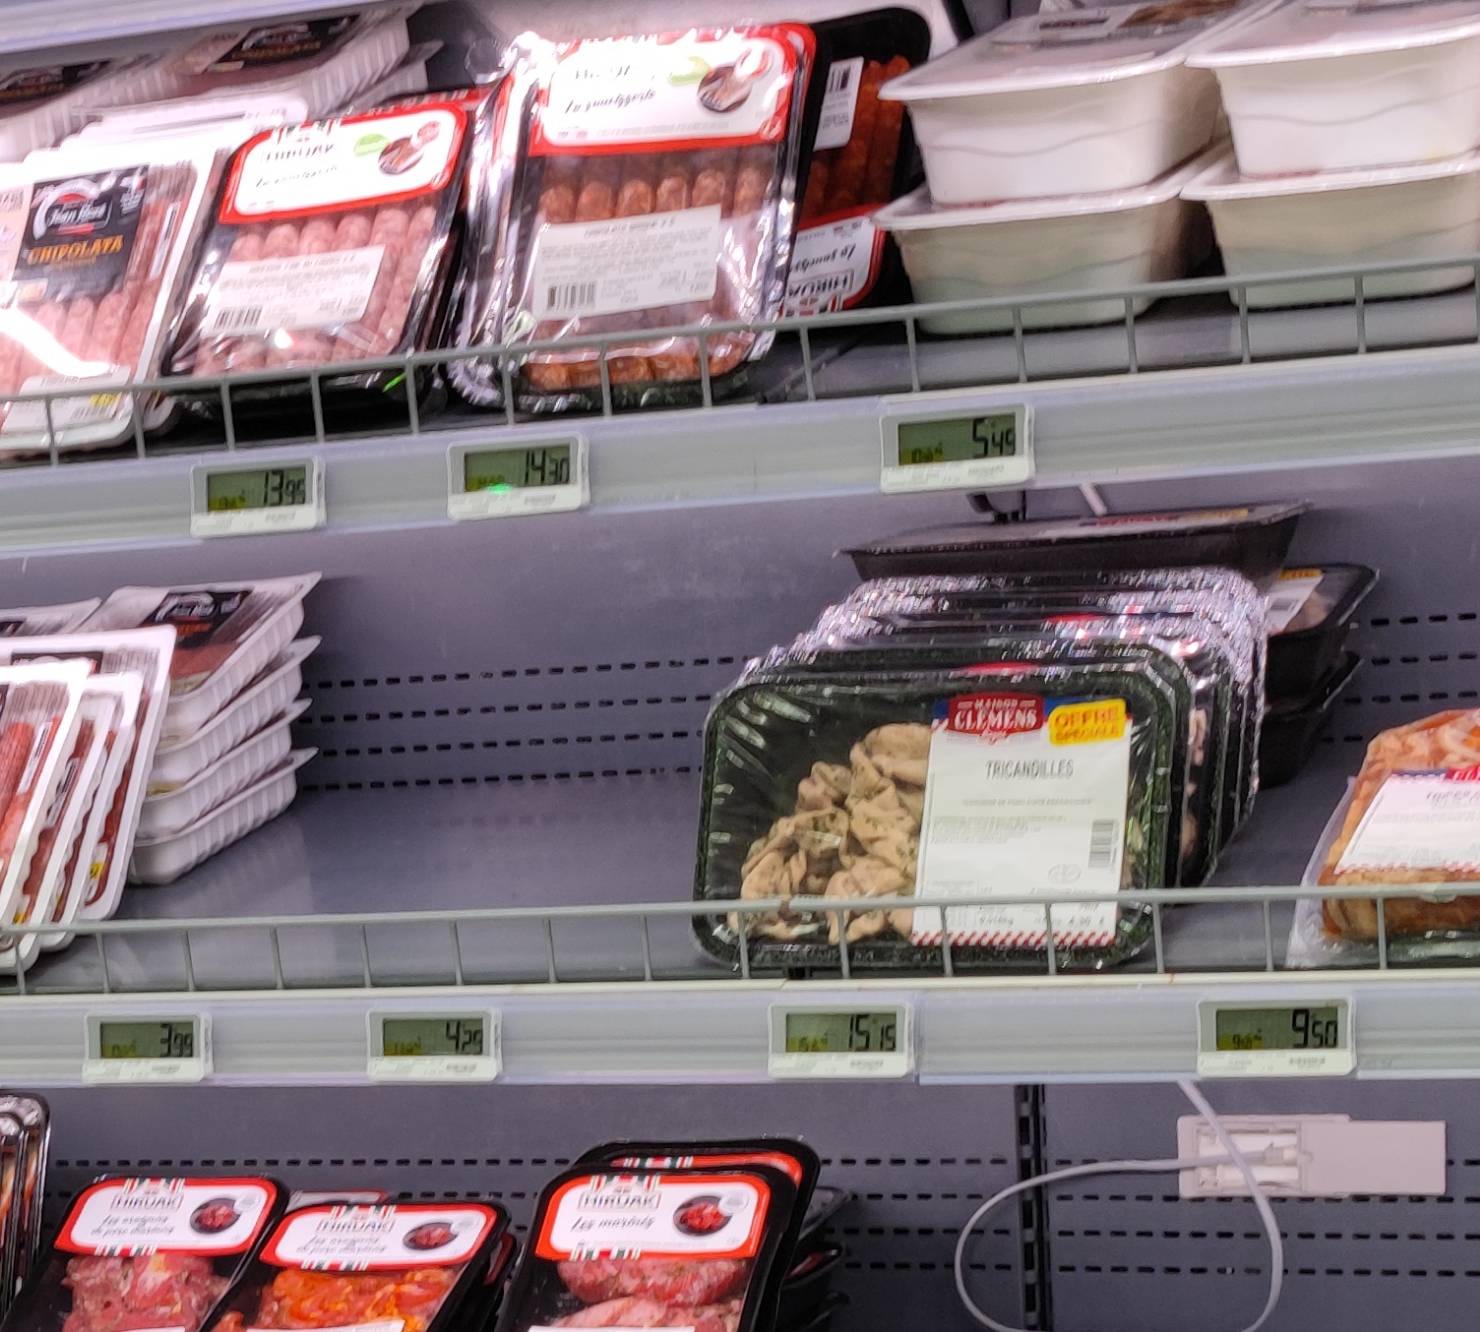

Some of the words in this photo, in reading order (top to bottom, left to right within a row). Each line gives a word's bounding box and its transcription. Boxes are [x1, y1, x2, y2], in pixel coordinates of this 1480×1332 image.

[954, 707, 1037, 730] CLEMENS
[1055, 706, 1119, 728] OFFRE
[986, 758, 1075, 780] TRICANDILLES
